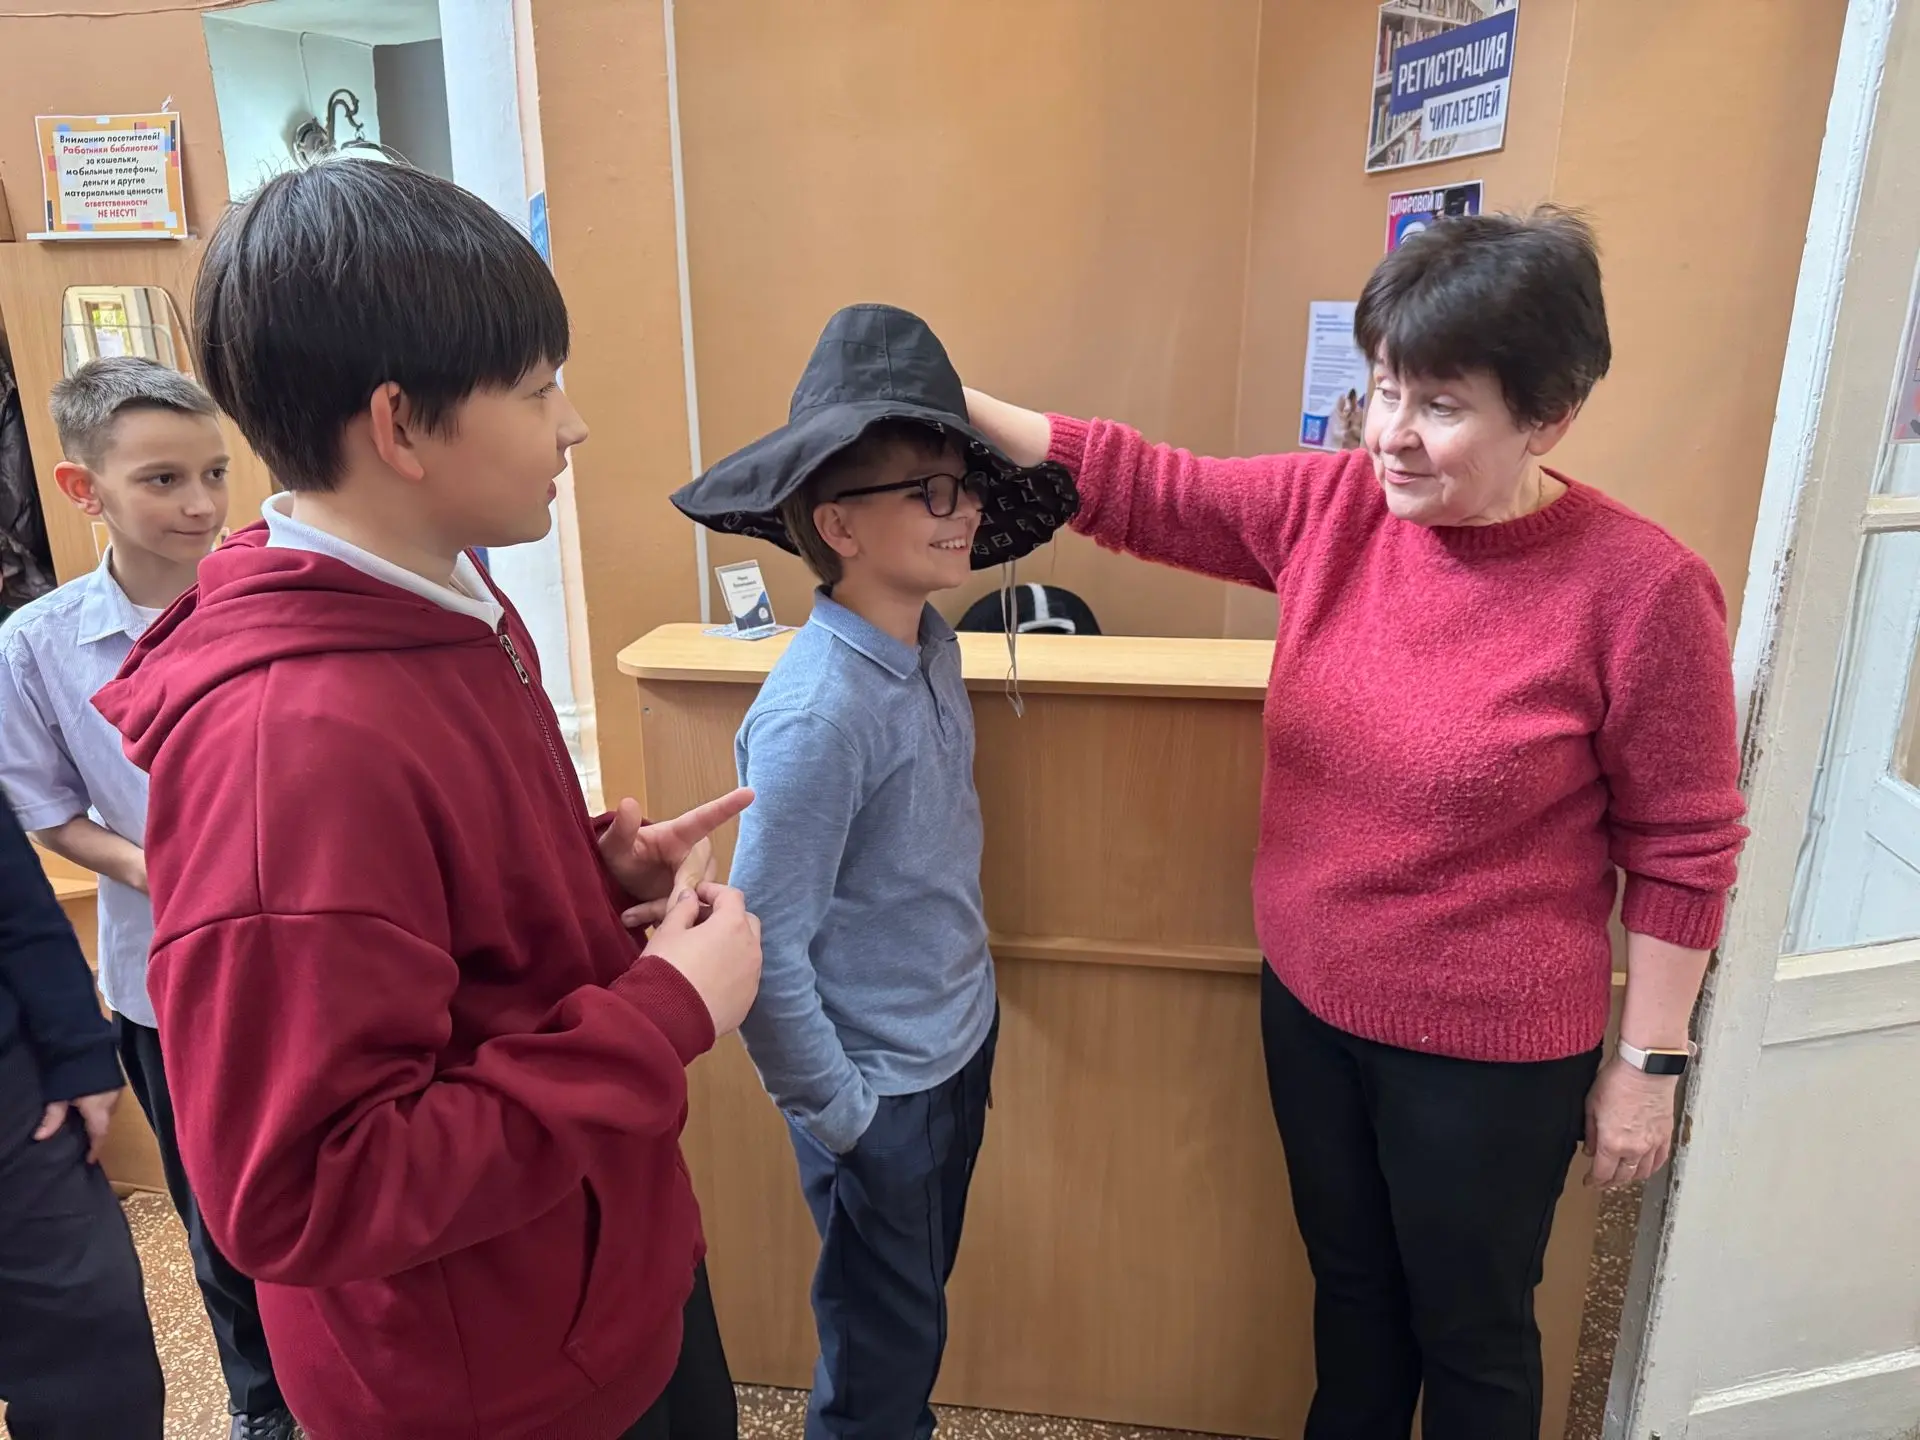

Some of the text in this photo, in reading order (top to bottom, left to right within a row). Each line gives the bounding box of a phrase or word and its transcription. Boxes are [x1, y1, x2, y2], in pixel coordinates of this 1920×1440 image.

[1397, 32, 1508, 96] РЕГИСТРАЦИЯ
[1429, 84, 1501, 132] ЧИТАТЕЛЕЙ
[59, 132, 160, 144] Вниманию посетителей!
[63, 144, 158, 154] Работники библиотеки
[96, 156, 139, 165] кошельки,
[65, 165, 158, 176] мобильные телефоны,
[82, 179, 109, 188] деньги
[117, 178, 146, 187] другие
[64, 187, 163, 199] материальные ценности
[84, 199, 148, 207] ответственности
[1390, 191, 1434, 216] ЦИФРОВОЙ
[98, 208, 137, 218] НЕ НЕСУТ!
